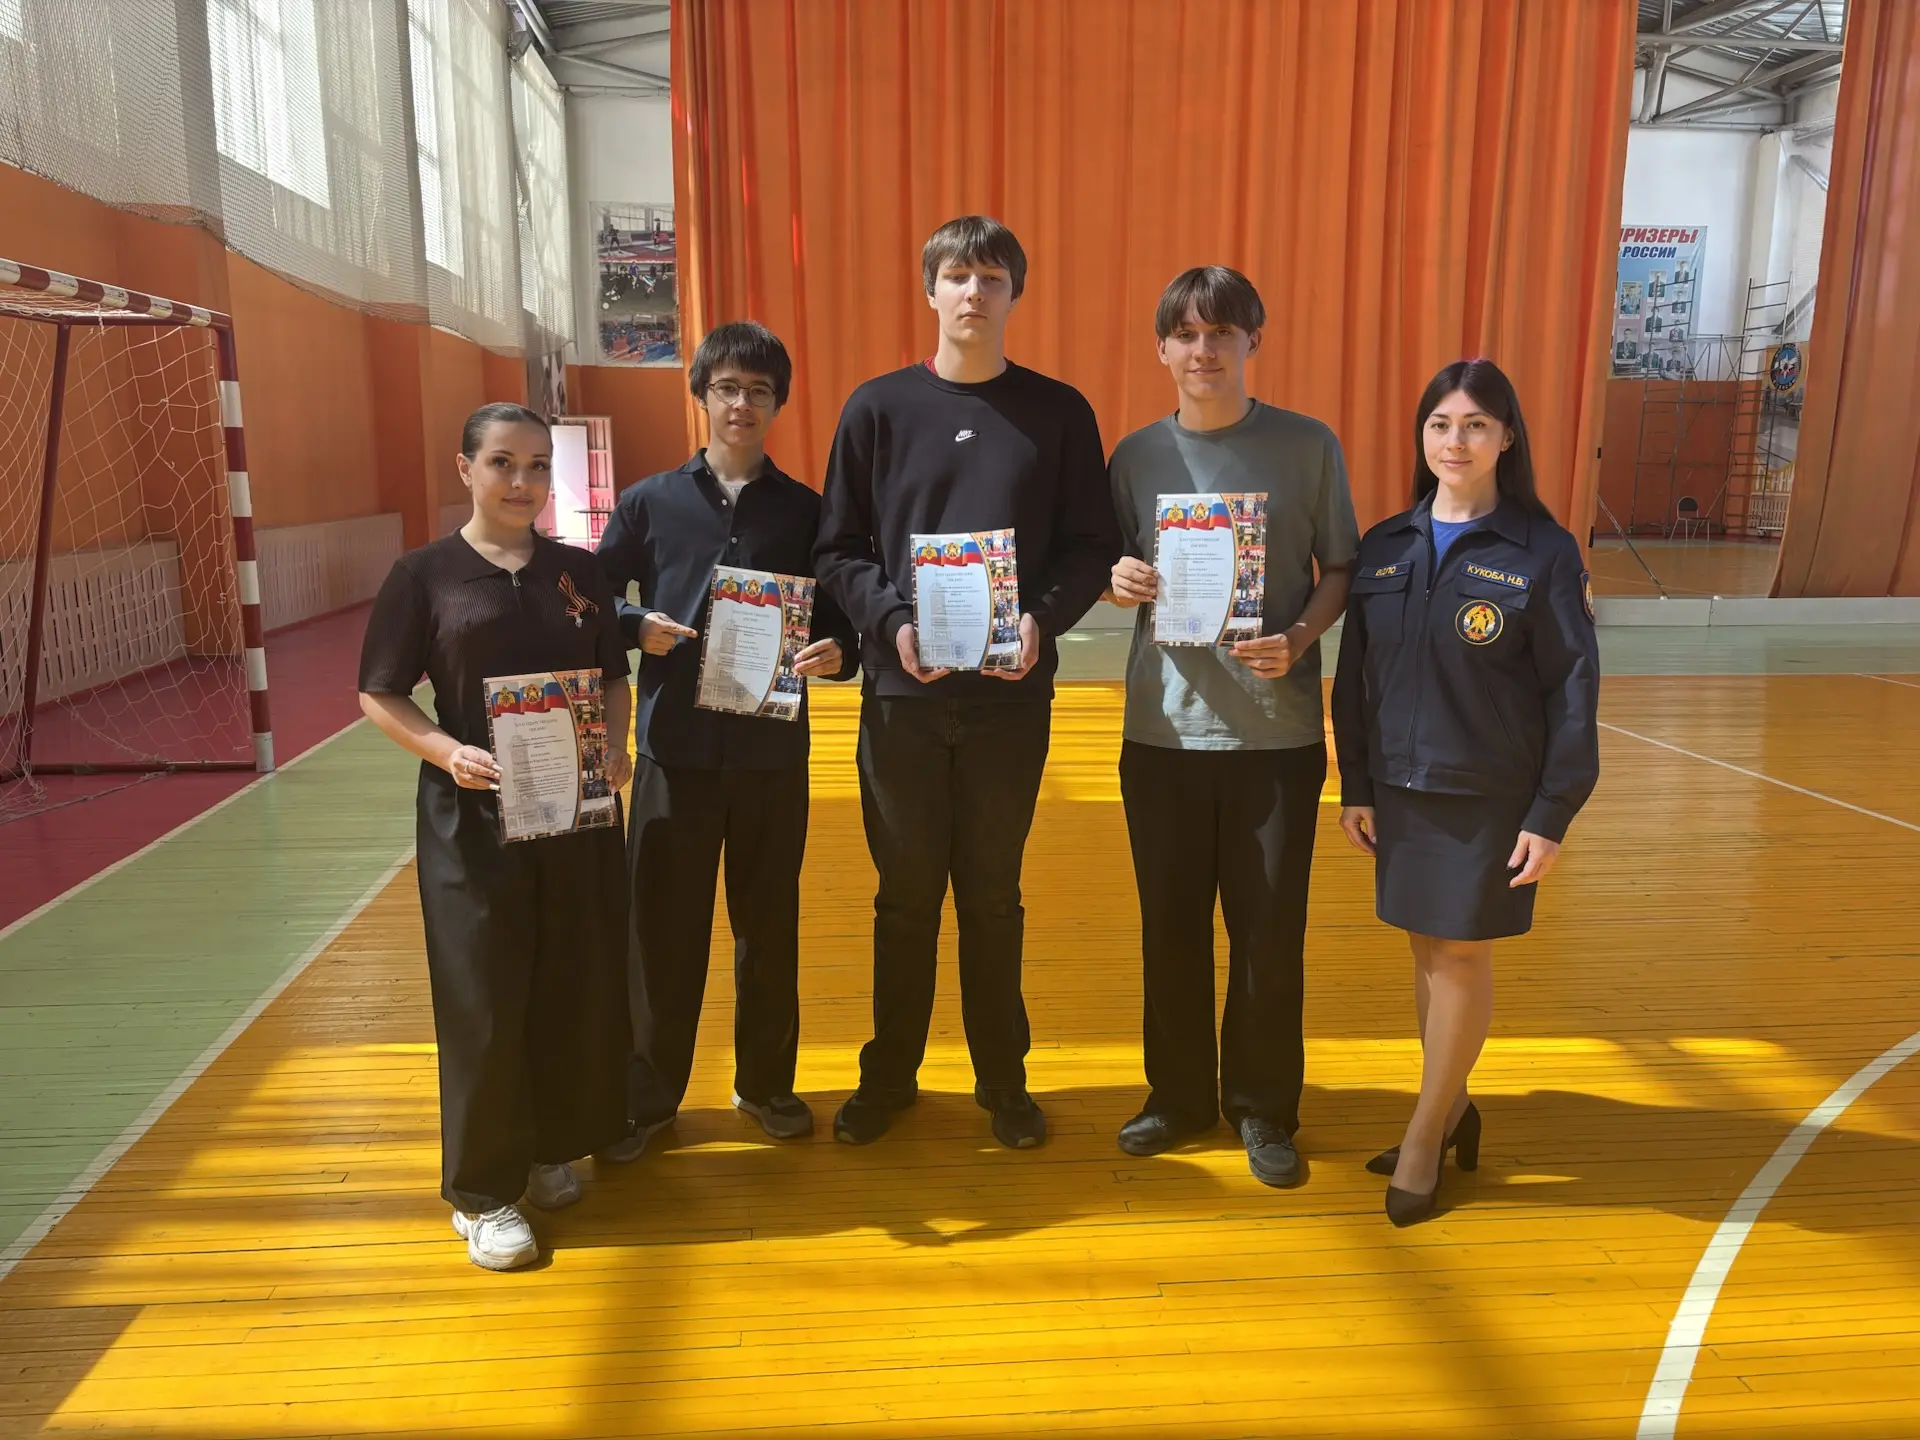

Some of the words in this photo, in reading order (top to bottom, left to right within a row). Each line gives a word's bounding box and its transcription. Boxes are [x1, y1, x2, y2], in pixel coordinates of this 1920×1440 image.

[1622, 246, 1677, 258] РОССИИ
[1467, 564, 1505, 581] КУКОБА
[1507, 575, 1525, 586] Н.В.
